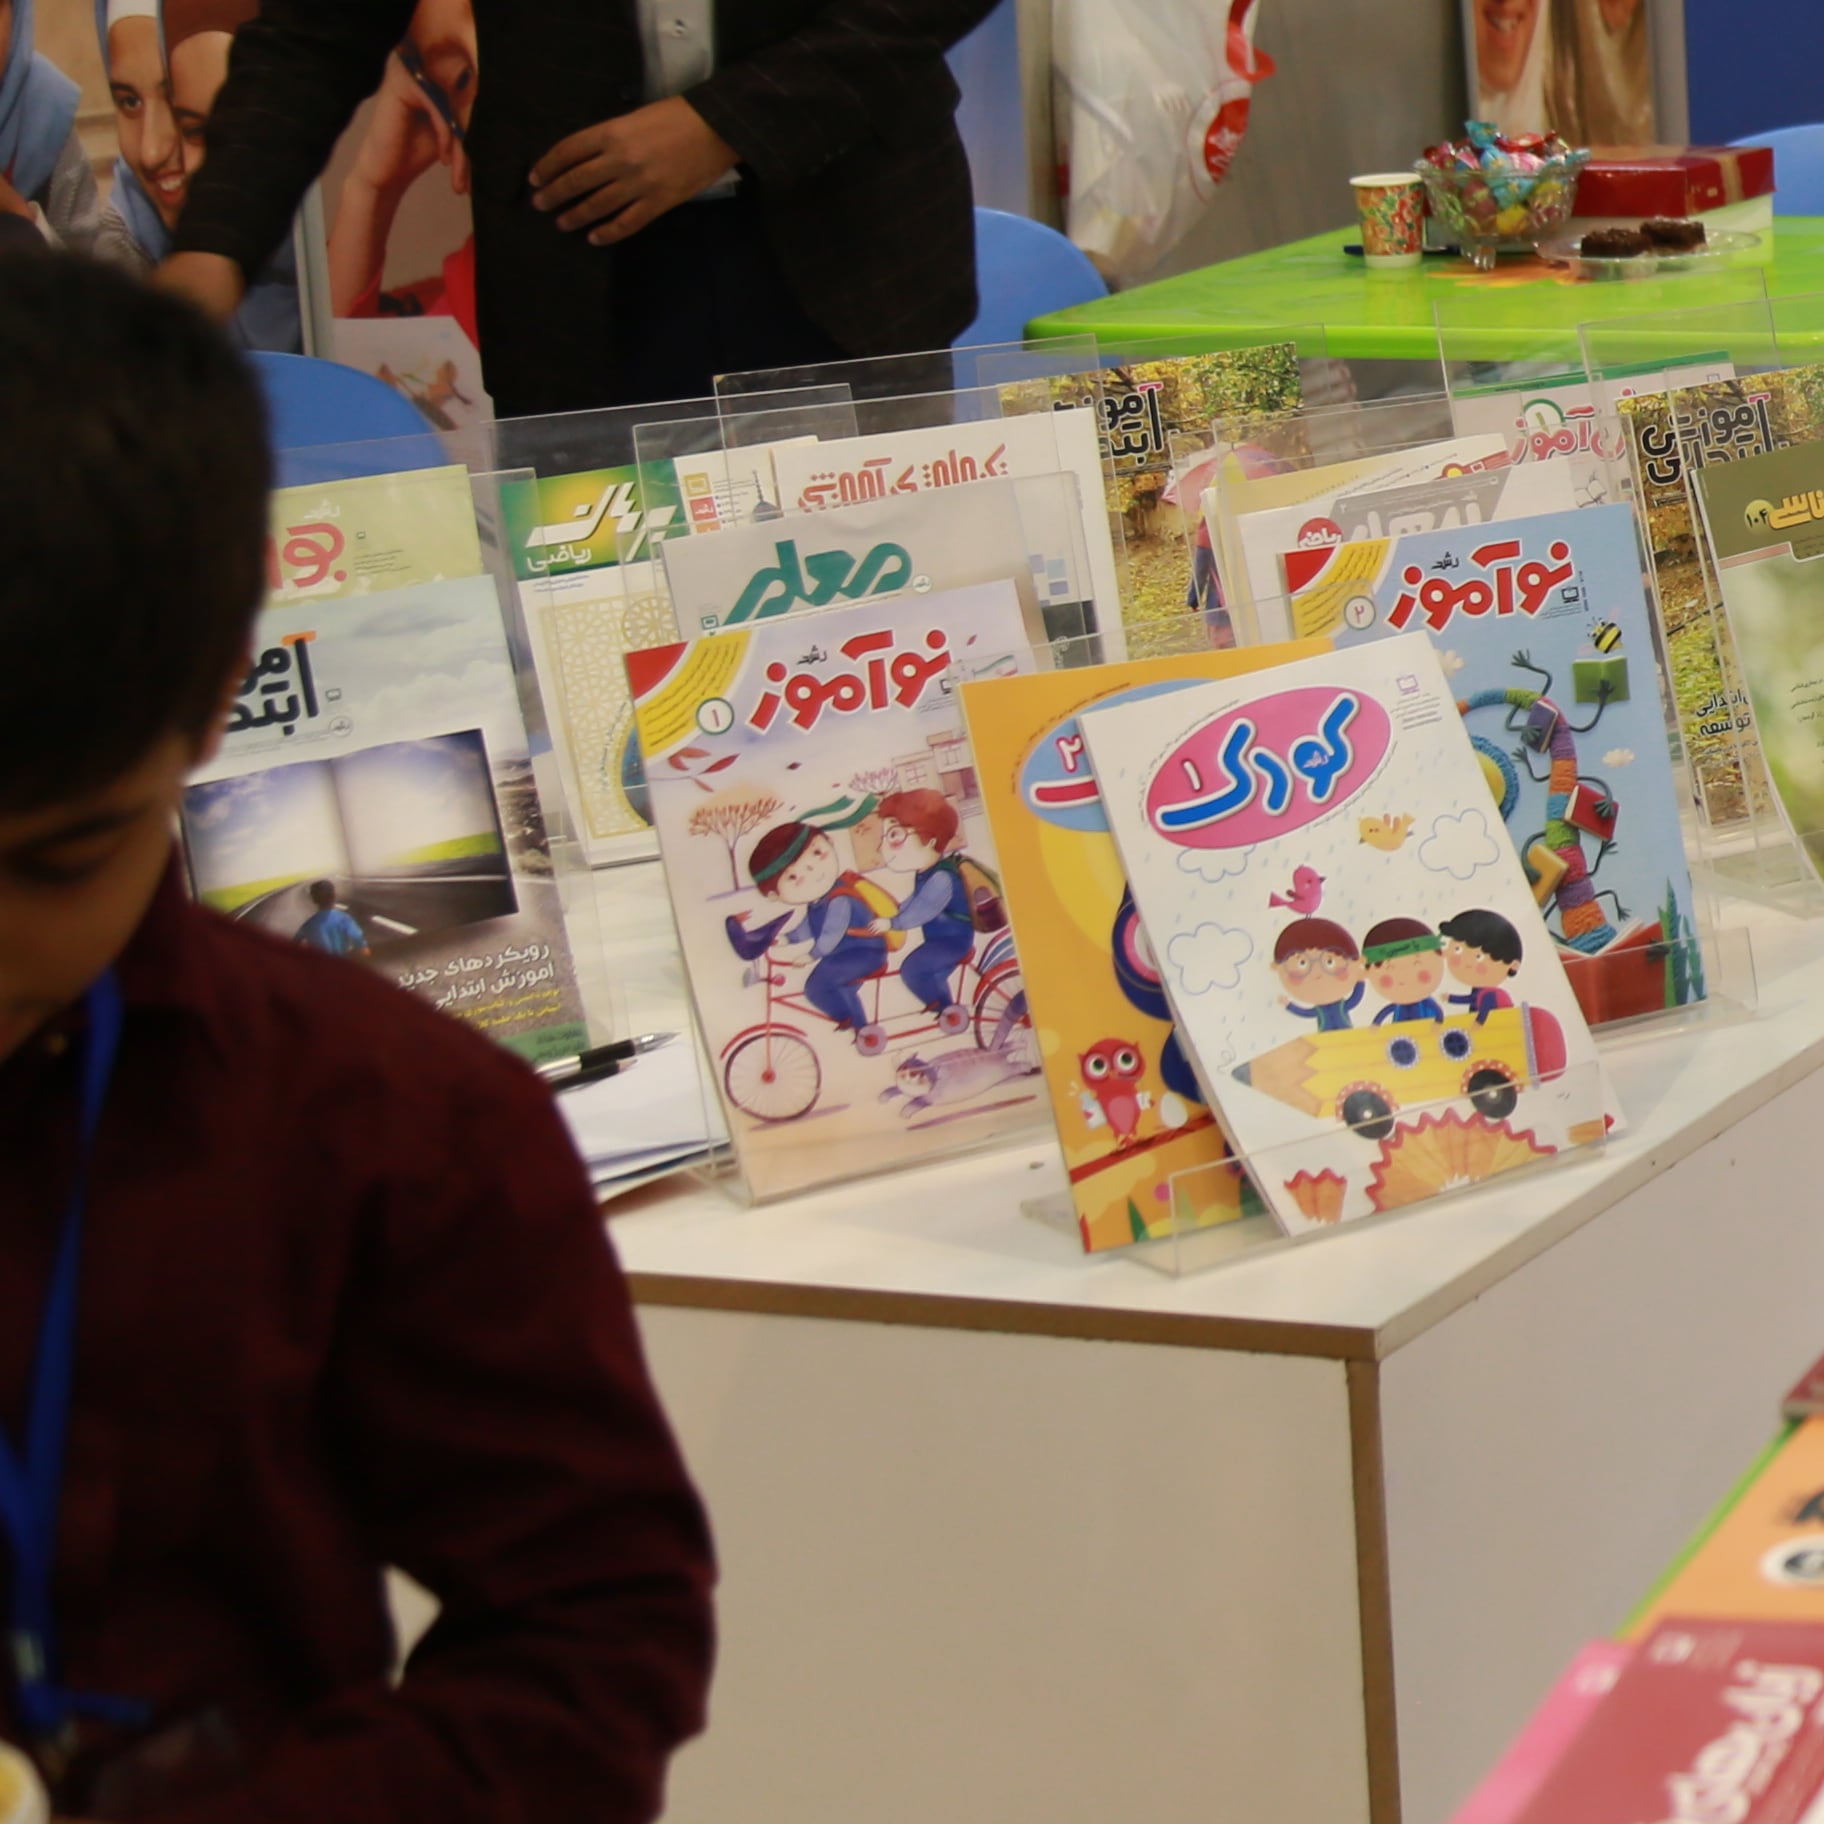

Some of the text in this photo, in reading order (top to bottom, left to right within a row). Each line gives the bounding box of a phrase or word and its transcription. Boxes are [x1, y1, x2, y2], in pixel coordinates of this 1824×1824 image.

[303, 498, 341, 520] رشد
[265, 522, 348, 590] جوا
[527, 544, 592, 573] ریاضی
[1431, 552, 1460, 570] رشد
[722, 539, 912, 626] معلم
[1387, 541, 1573, 632] نوآموز
[1353, 604, 1366, 624] ۲
[797, 645, 829, 666] رشد
[749, 629, 951, 731] نوآموز
[710, 707, 720, 728] ۱
[1161, 696, 1355, 828] کودک
[1183, 760, 1201, 791] ۱
[444, 943, 550, 976] رویکردهای
